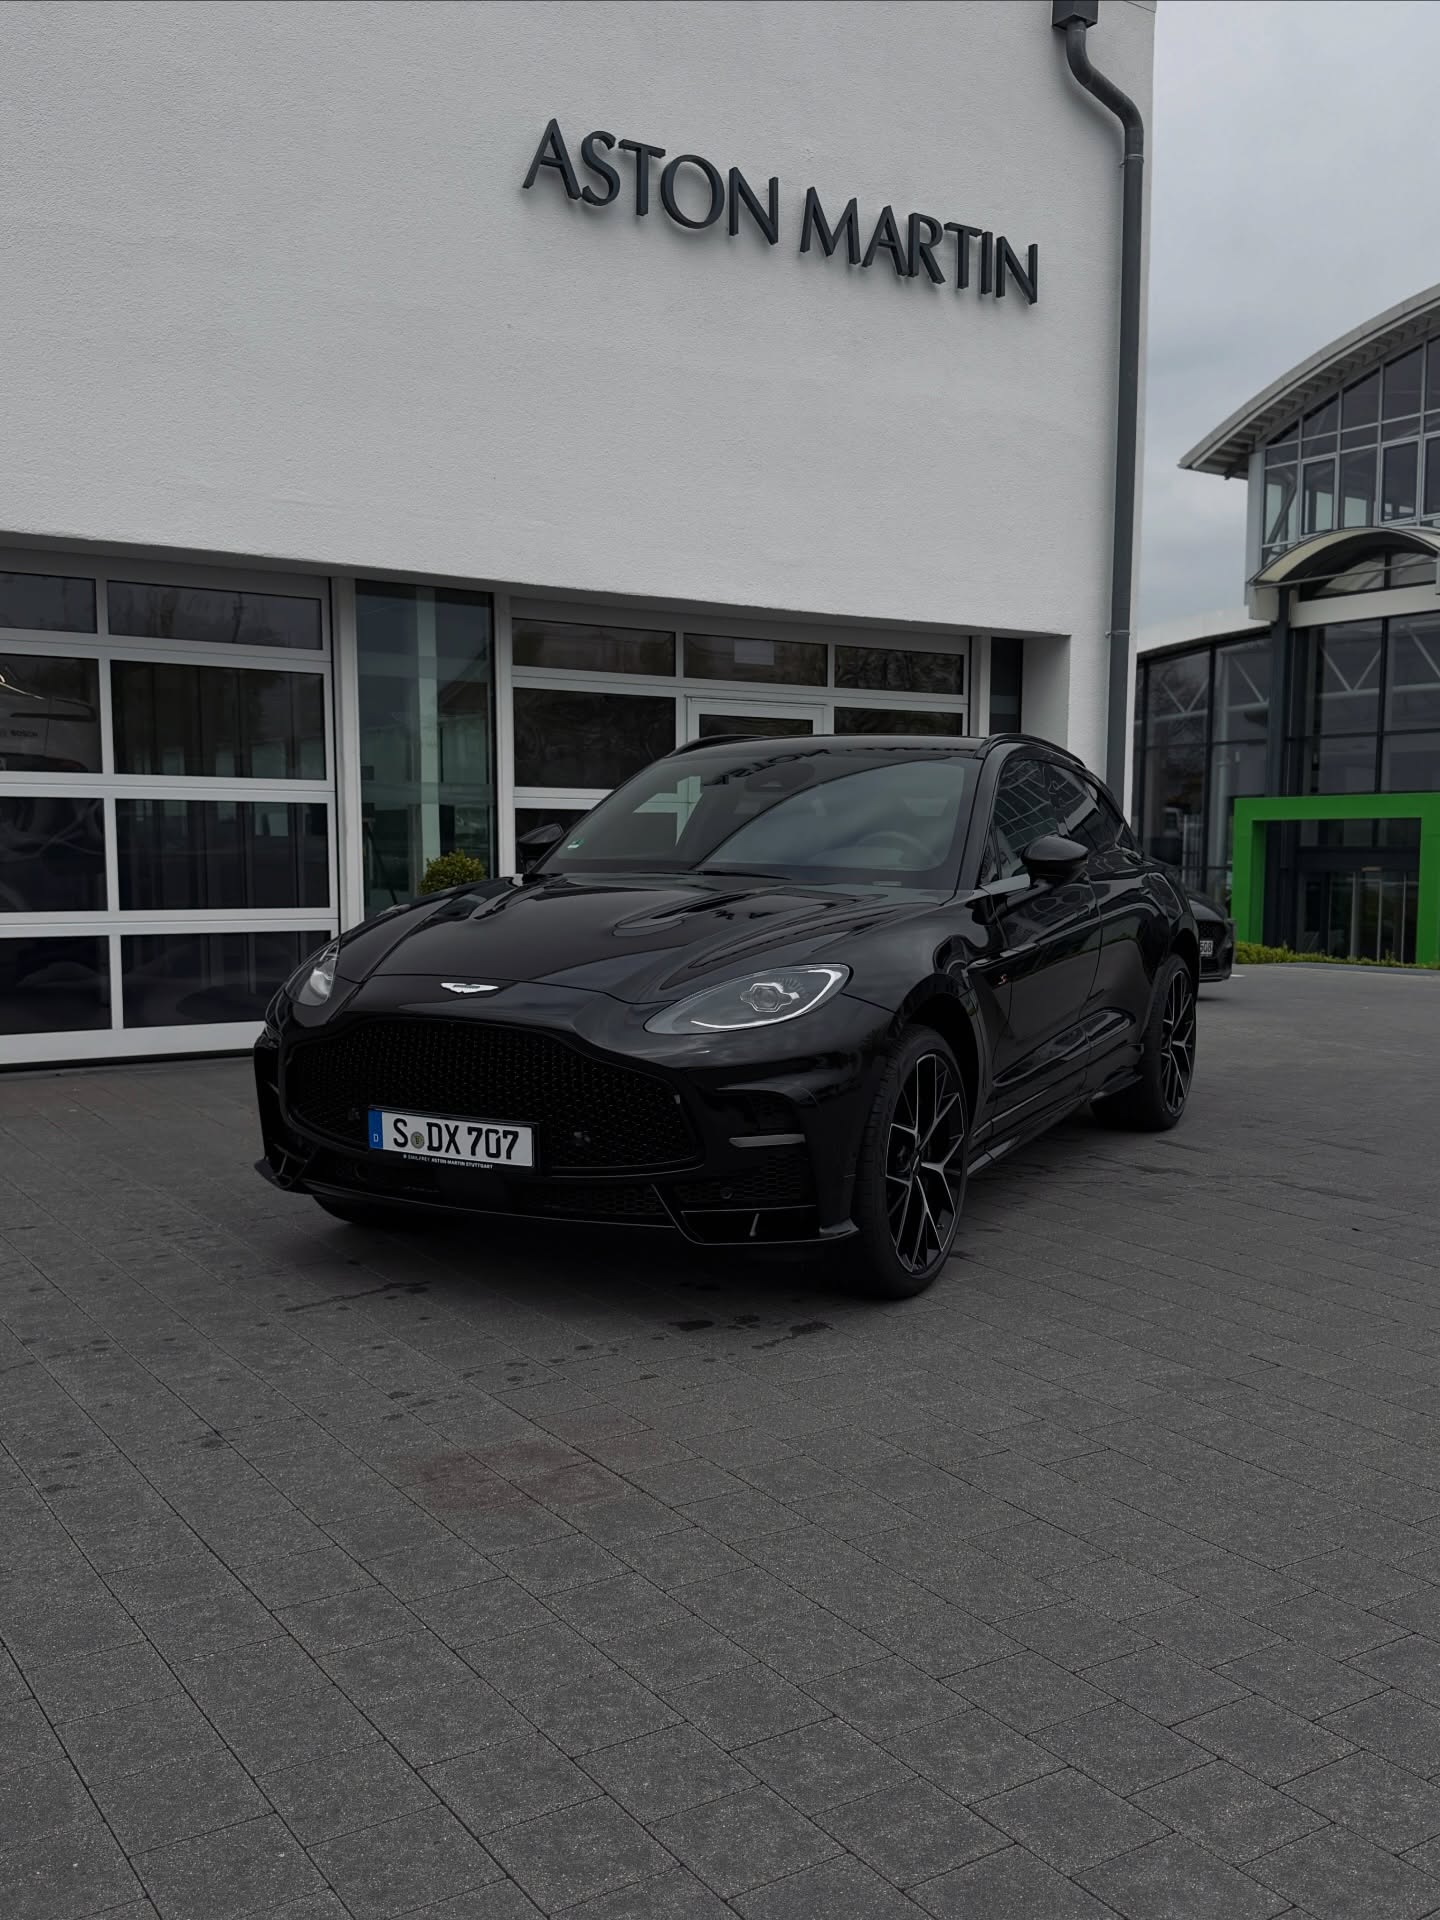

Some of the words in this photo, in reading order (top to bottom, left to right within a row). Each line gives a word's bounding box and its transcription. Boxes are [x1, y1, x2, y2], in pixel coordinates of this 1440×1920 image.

[522, 118, 779, 245] ASTON
[800, 187, 1038, 305] MARTIN
[373, 1133, 379, 1142] D
[393, 1118, 409, 1148] S
[426, 1122, 461, 1155] DX
[467, 1126, 519, 1160] 707
